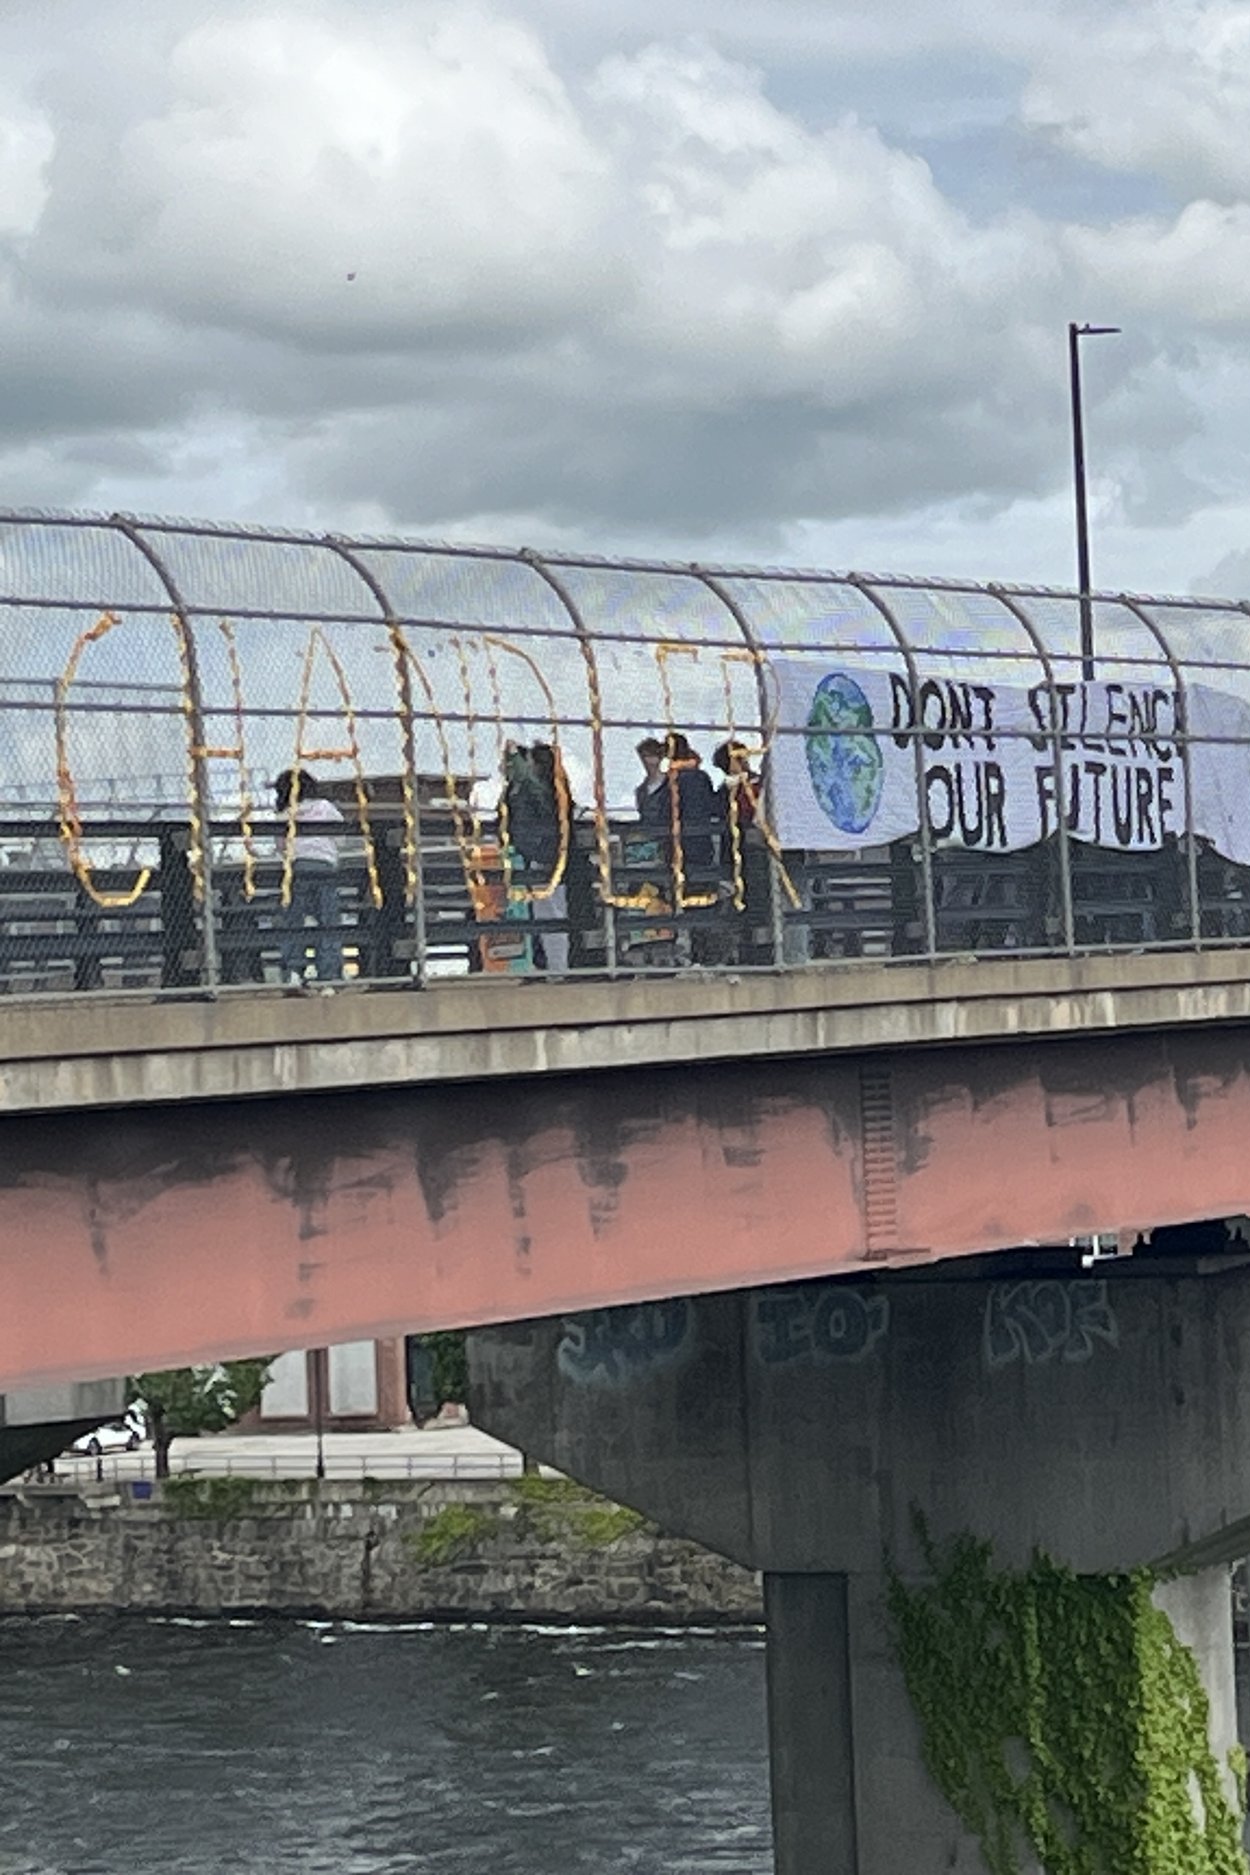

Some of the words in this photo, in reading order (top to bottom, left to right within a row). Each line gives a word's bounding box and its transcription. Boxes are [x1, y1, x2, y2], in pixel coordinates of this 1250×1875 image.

[889, 672, 997, 751] DONT
[926, 762, 1007, 847] OUR
[1035, 762, 1175, 847] FUTURE
